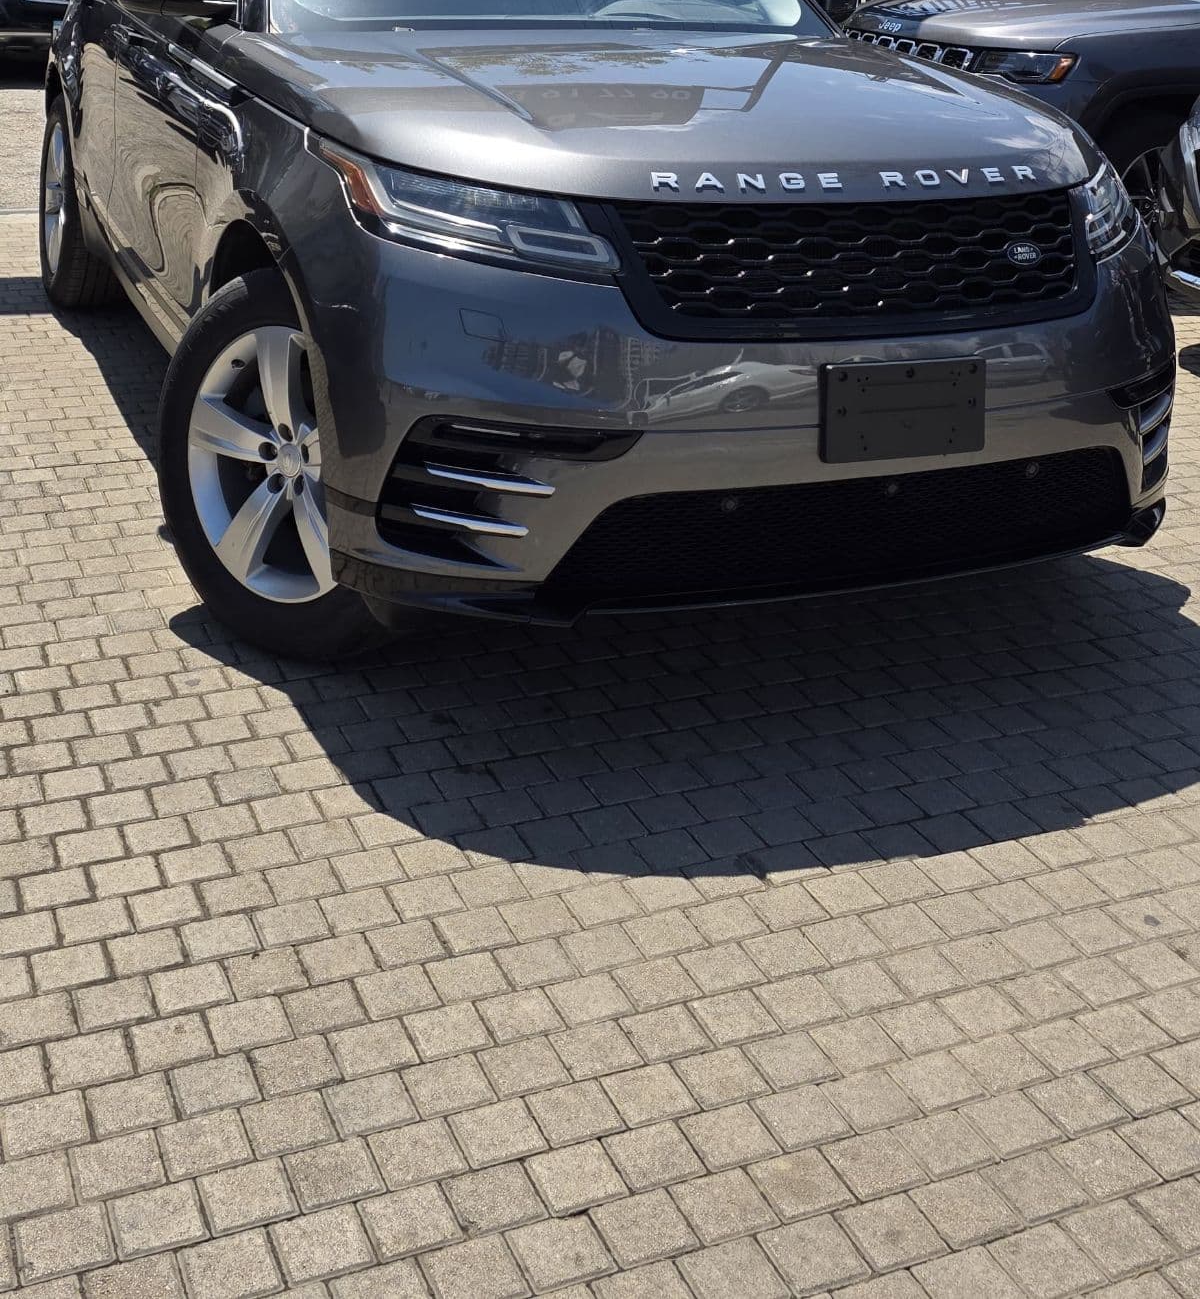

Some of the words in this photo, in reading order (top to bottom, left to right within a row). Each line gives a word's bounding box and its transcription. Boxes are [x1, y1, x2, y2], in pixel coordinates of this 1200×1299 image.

[878, 18, 902, 33] Jeep
[650, 171, 844, 192] RANGE
[880, 165, 1037, 188] ROVER
